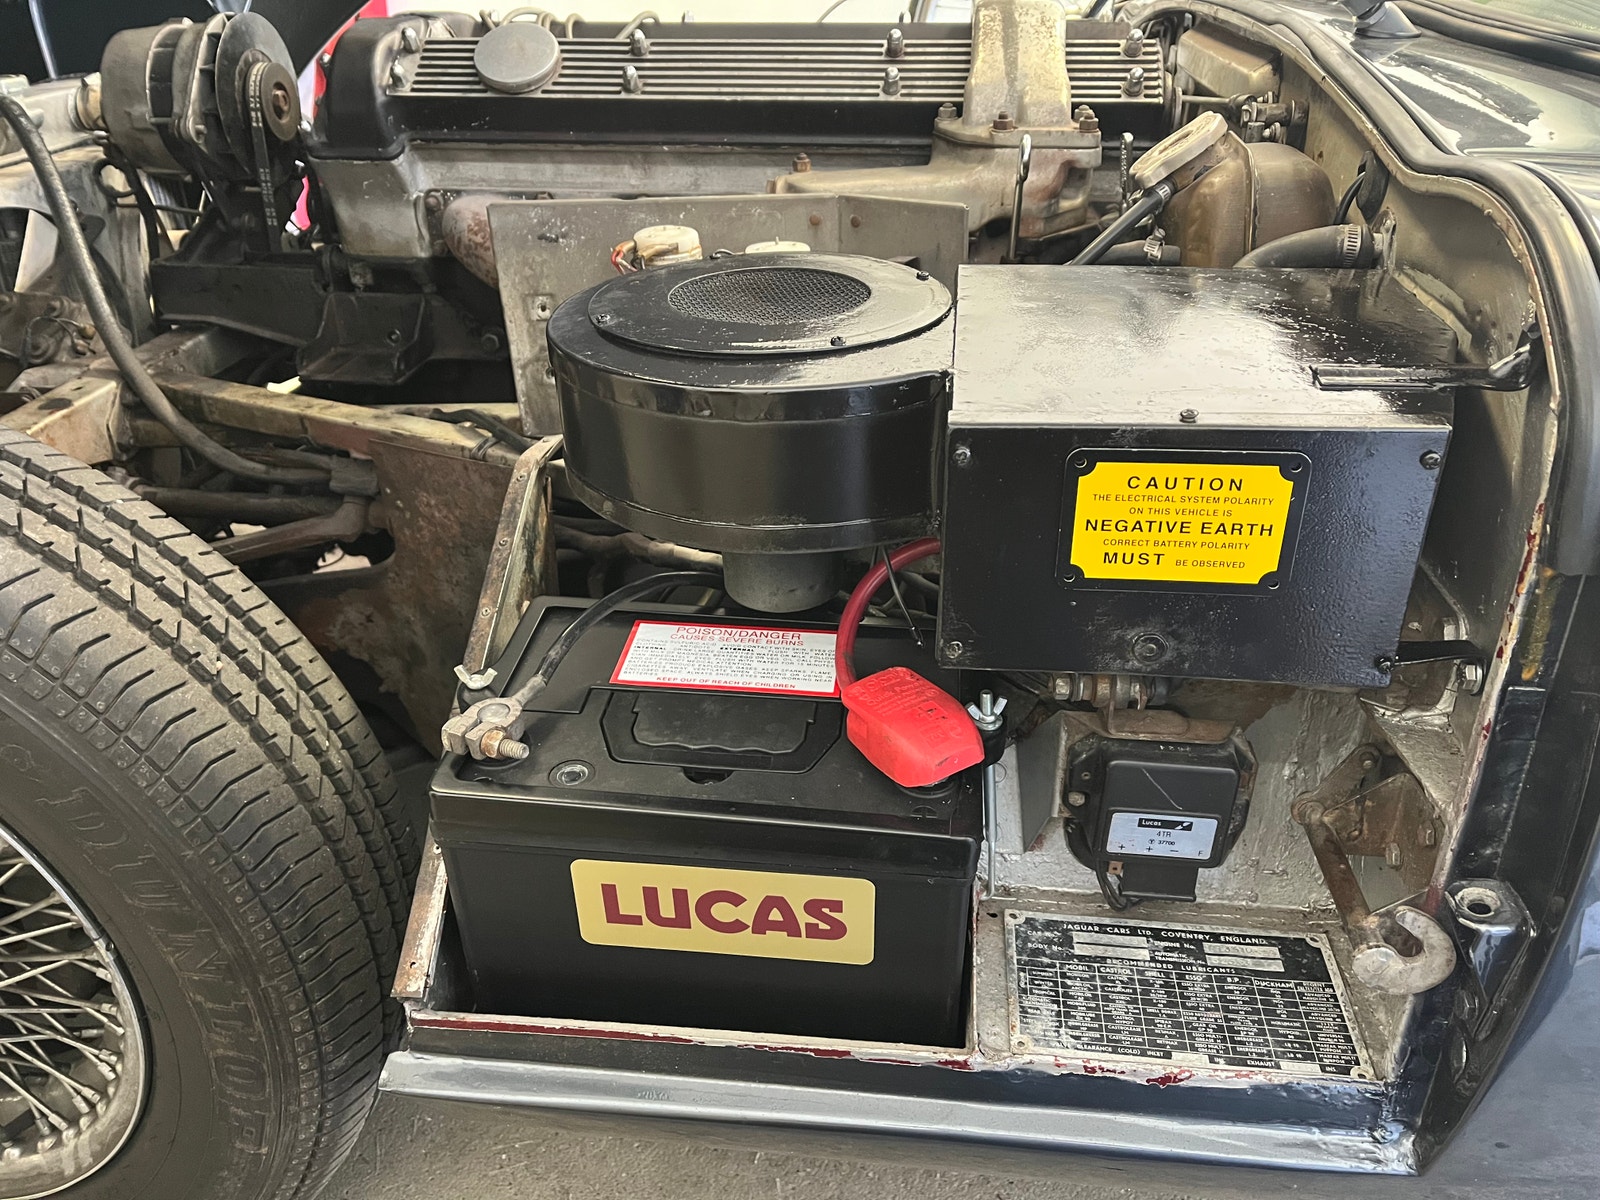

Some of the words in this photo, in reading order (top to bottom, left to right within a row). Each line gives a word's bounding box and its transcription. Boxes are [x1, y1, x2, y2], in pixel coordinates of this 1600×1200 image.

[1127, 475, 1244, 492] CAUTION
[1092, 493, 1111, 502] THE
[1114, 494, 1177, 504] ELECTRICAL
[1179, 495, 1220, 504] SYSTEM
[1223, 497, 1275, 506] POLARITY
[1129, 507, 1143, 515] ON
[1146, 507, 1171, 516] THIS
[1174, 508, 1219, 517] VEHICLE
[1223, 509, 1233, 517] IS
[1085, 518, 1192, 534] NEGATIVE
[1200, 522, 1274, 537] EARTH
[1103, 538, 1150, 547] CORRECT
[1153, 540, 1198, 548] BATTERY
[1200, 541, 1250, 550] POLARITY
[1103, 551, 1165, 566] MUST
[1175, 559, 1188, 567] BE
[1191, 560, 1246, 569] OBSERVED
[669, 633, 716, 641] CAUSES
[718, 636, 762, 644] SEVERE
[676, 626, 801, 640] POISON/DANGER
[1141, 819, 1162, 827] Lucas
[1156, 830, 1172, 838] 4TR
[600, 883, 848, 941] LUCAS
[1063, 923, 1100, 932] JAGUAR
[1106, 927, 1130, 935] CARS
[1161, 931, 1213, 941] COVENTRY,
[1027, 942, 1048, 950] BODY
[1100, 967, 1132, 975] CASTROL
[1106, 958, 1173, 969] RECOMMENDED
[1181, 965, 1236, 974] LUBRICANTS
[1145, 970, 1166, 978] SHELL
[1255, 980, 1293, 988] DUCKHAM
[1076, 1044, 1113, 1052] CLEARANCE
[1117, 1047, 1141, 1055] (COLD)
[1246, 1059, 1275, 1067] EXHAUST
